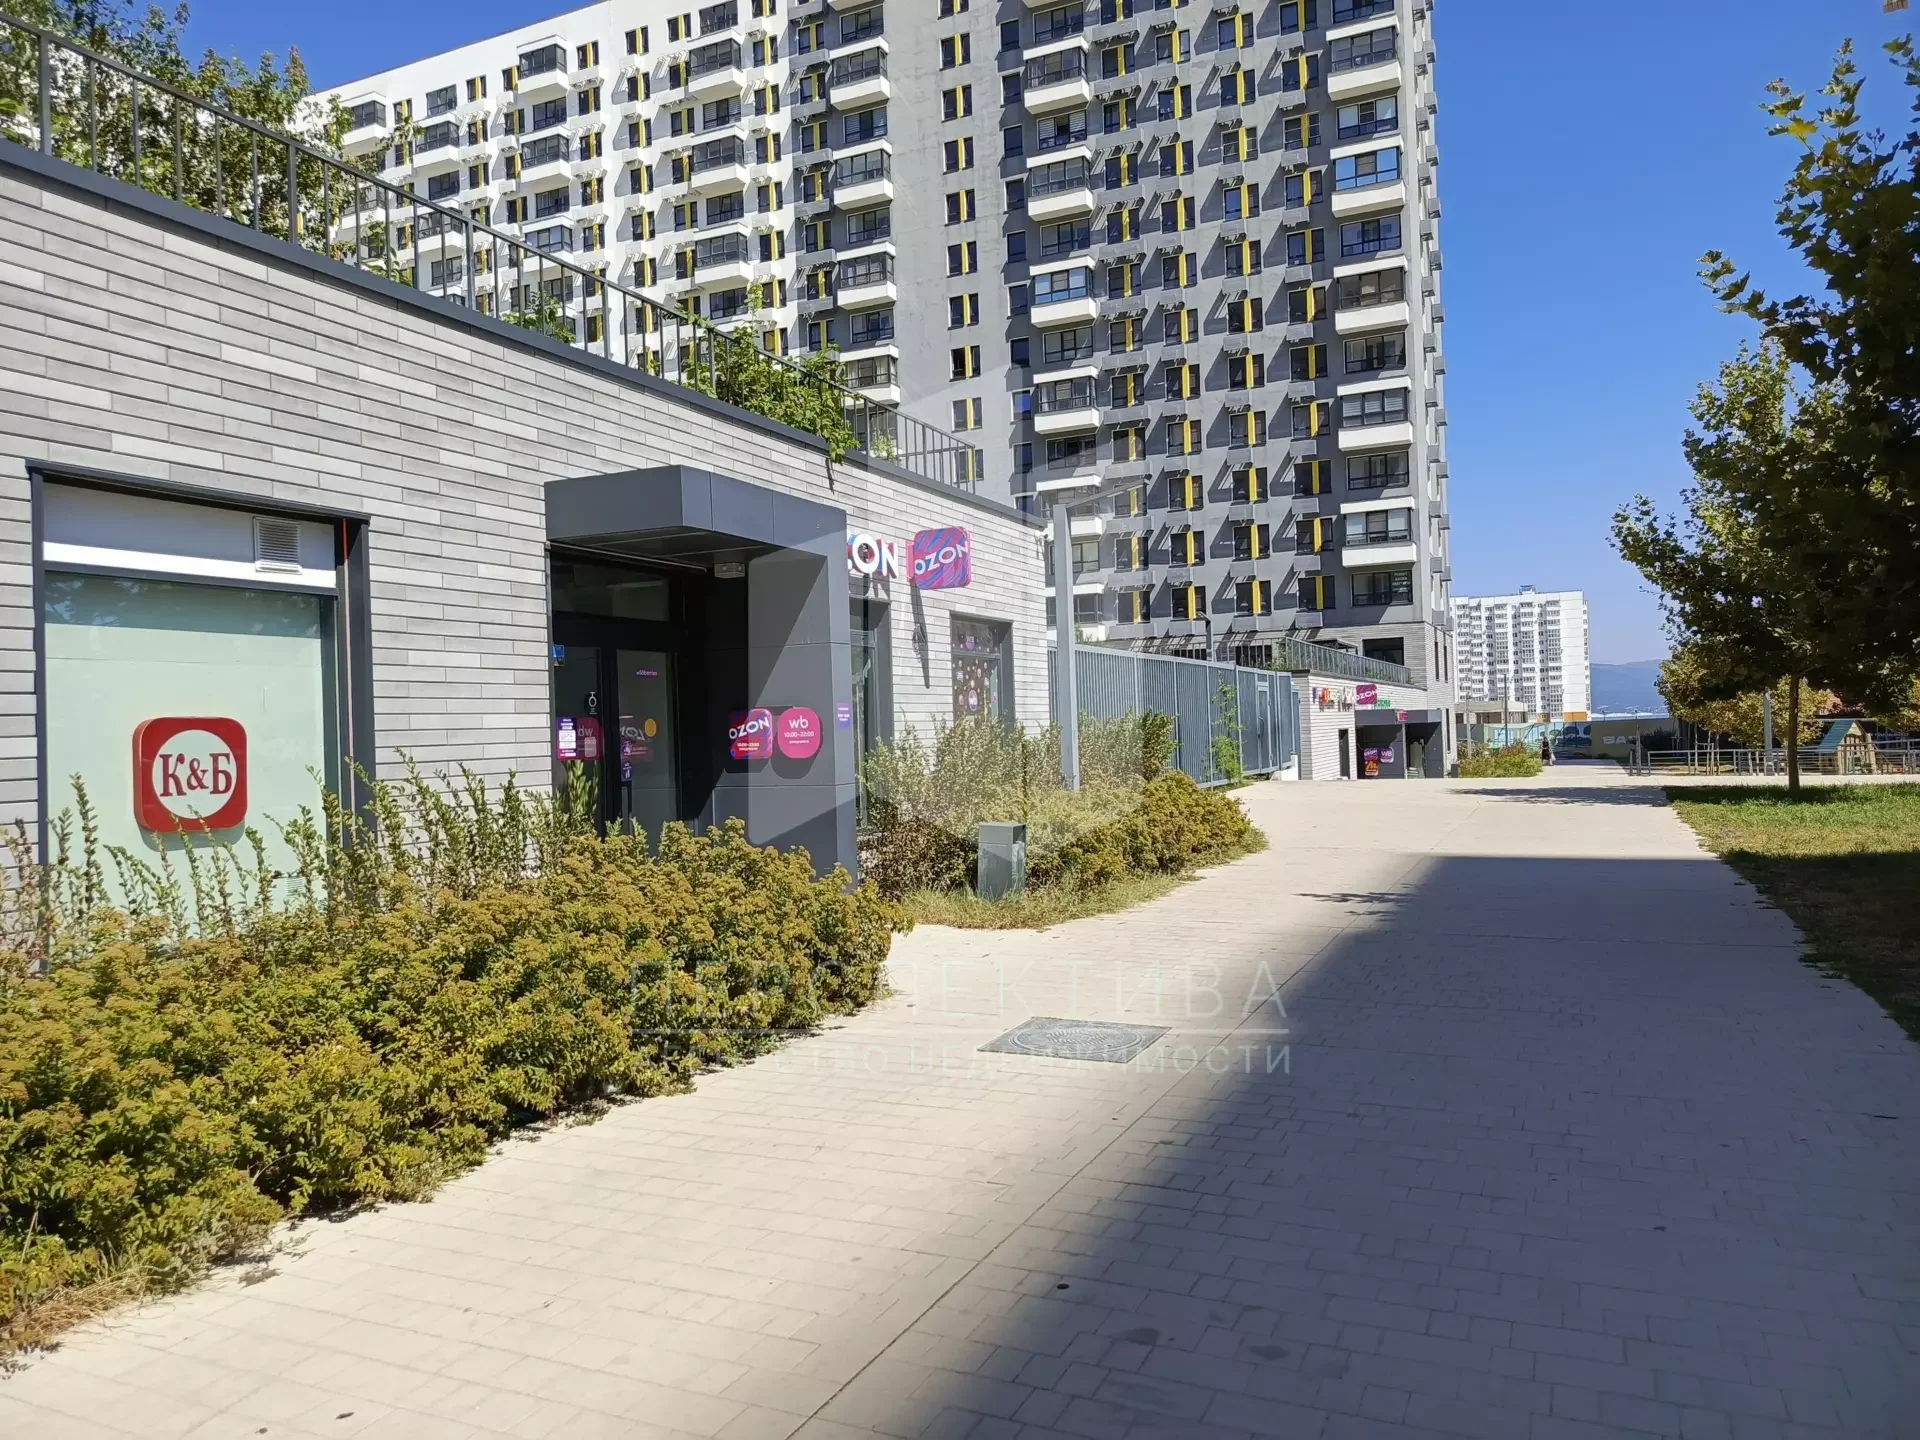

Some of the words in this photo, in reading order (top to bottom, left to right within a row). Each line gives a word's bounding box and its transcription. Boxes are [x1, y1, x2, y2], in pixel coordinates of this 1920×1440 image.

[848, 533, 898, 578] ON
[914, 541, 970, 575] OZON
[728, 716, 771, 740] OZON
[788, 715, 809, 729] wb
[159, 752, 233, 797] К&Б
